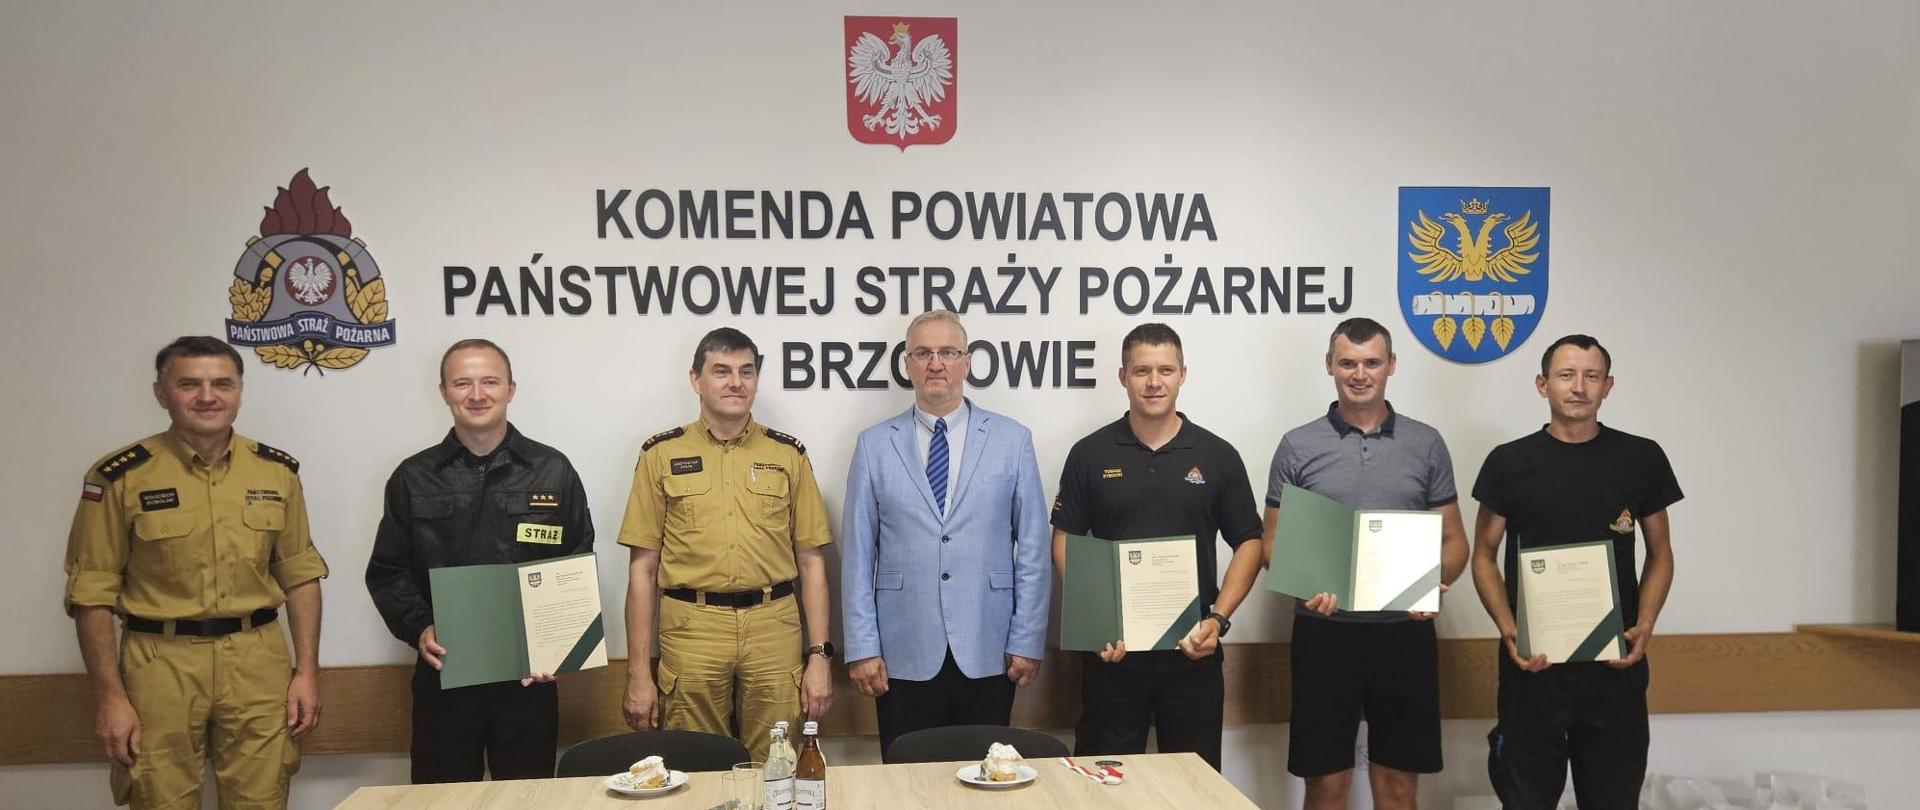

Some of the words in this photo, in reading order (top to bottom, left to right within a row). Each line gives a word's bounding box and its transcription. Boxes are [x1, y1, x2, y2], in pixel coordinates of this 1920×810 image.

[596, 188, 875, 240] KOMENDA
[891, 190, 1218, 241] POWIATOWA
[443, 252, 835, 316] PAŃSTWOWEJ
[855, 252, 1062, 316] STRAŻY
[1079, 253, 1354, 316] POŻARNEJ
[230, 323, 295, 342] PAŃSTWOWA
[297, 317, 329, 333] STRAŻ
[335, 326, 391, 343] POŻARNA
